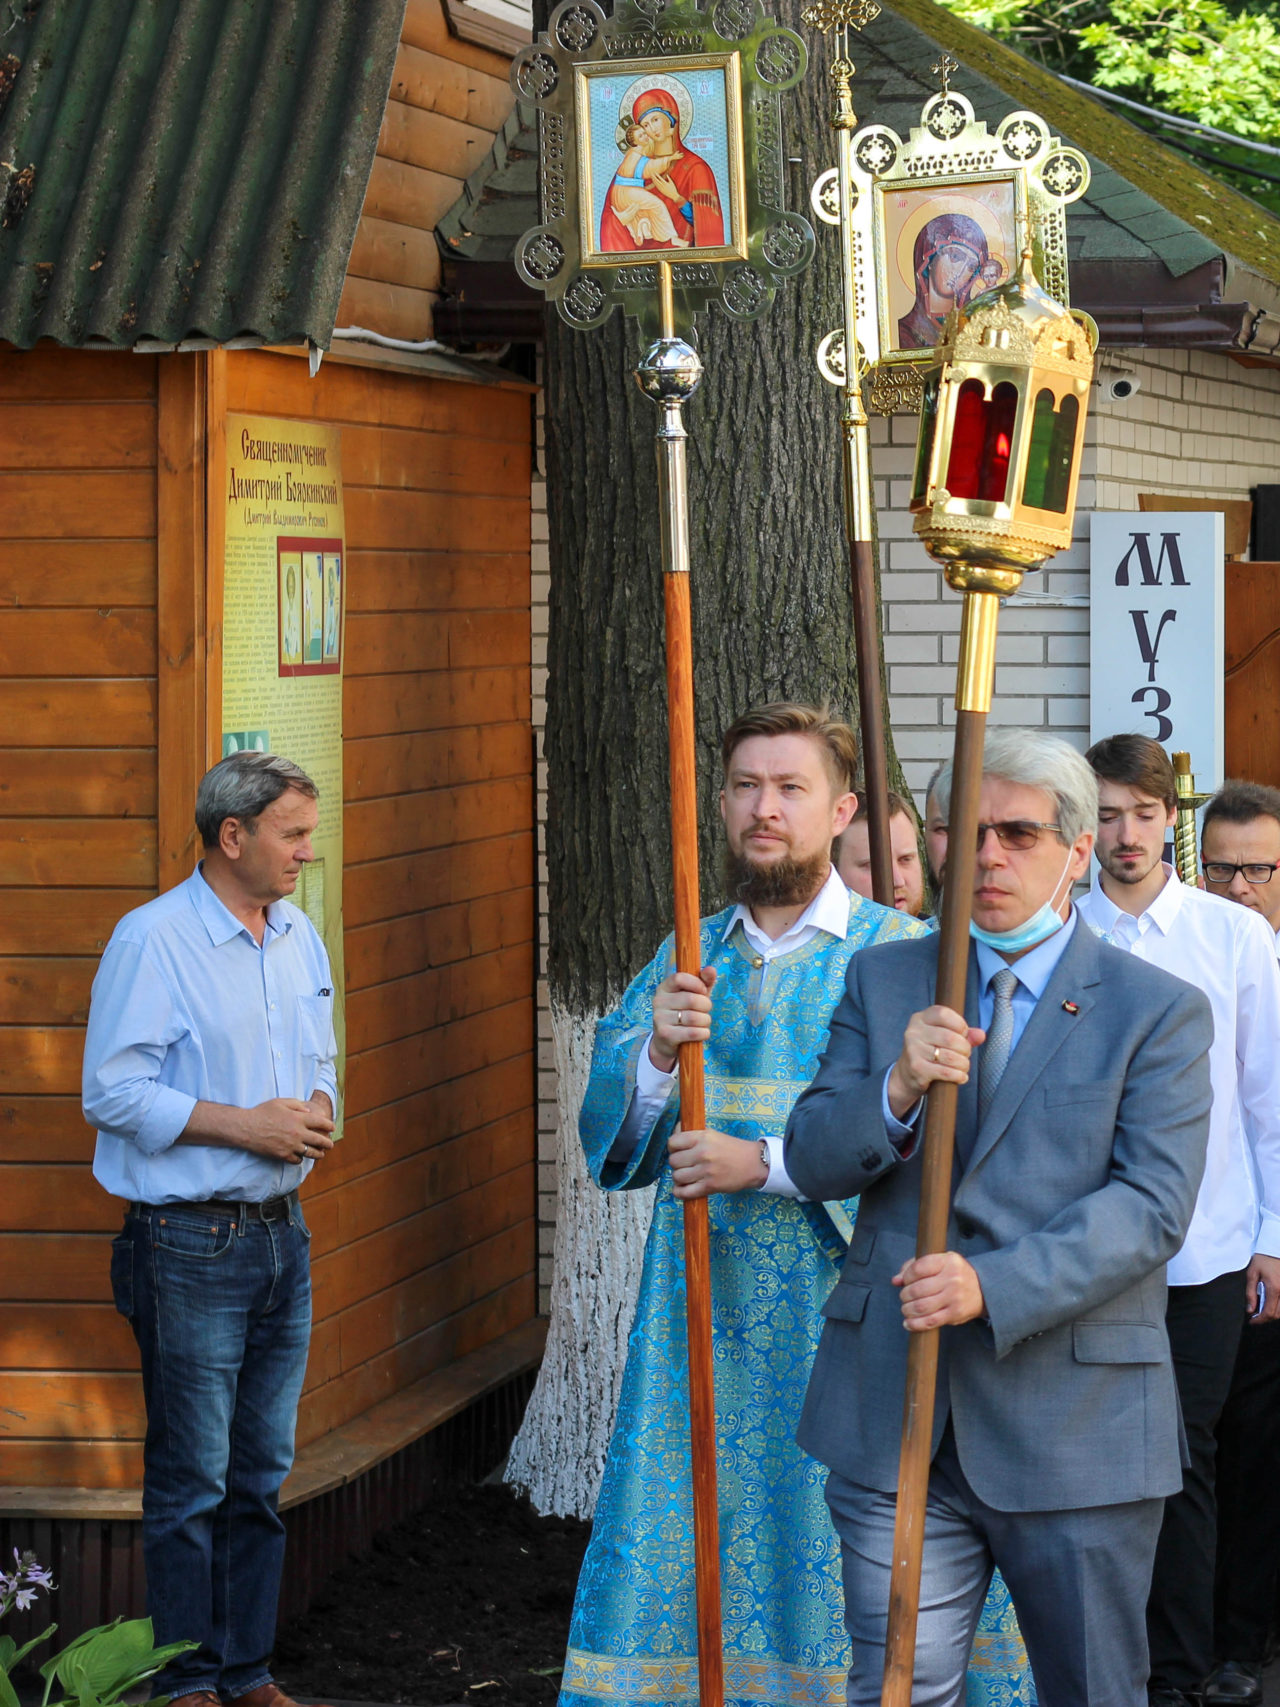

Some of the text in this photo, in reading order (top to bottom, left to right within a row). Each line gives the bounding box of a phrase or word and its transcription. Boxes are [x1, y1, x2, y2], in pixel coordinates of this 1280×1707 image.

[241, 428, 327, 475] Священномученик
[229, 467, 338, 512] Димитрий Бояркинский
